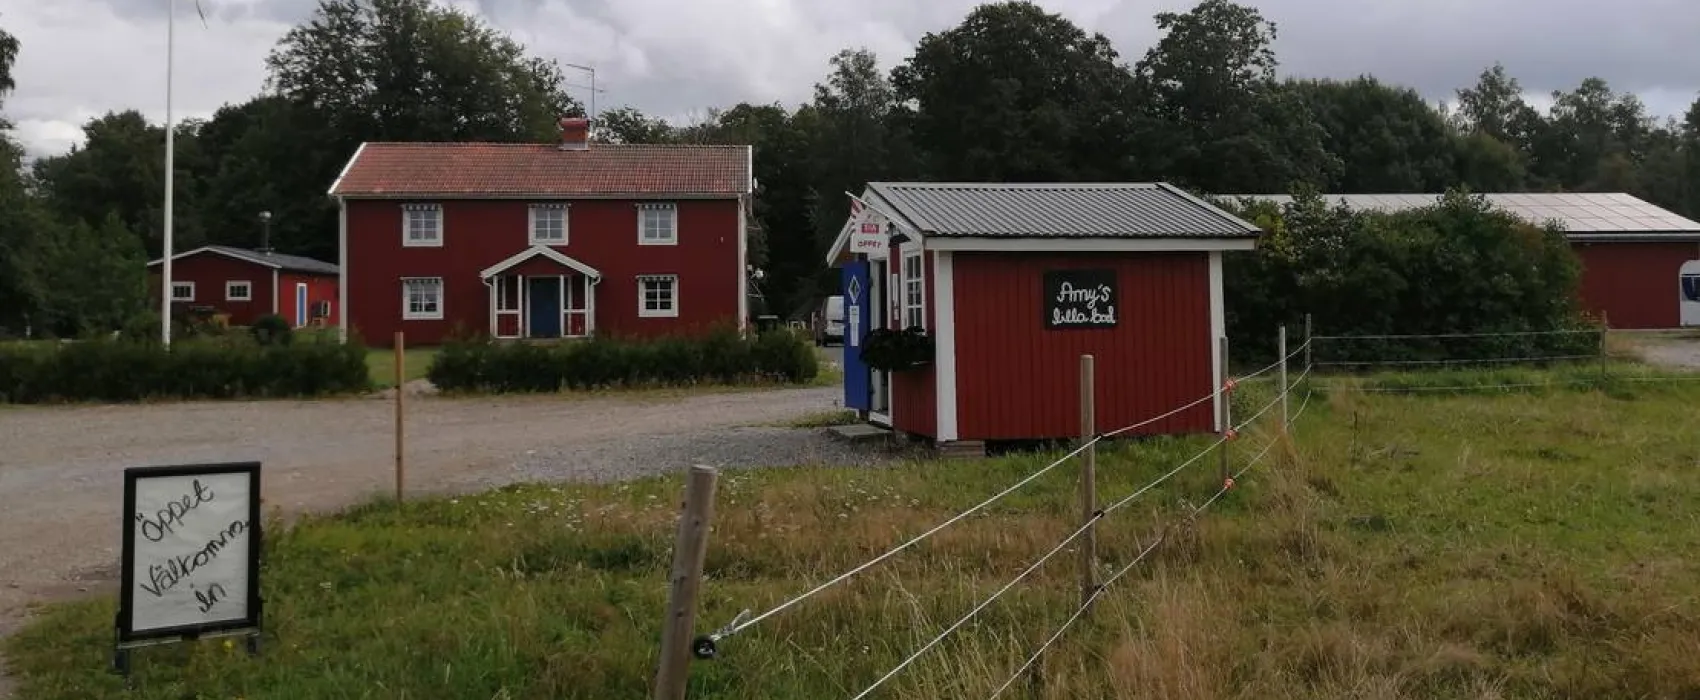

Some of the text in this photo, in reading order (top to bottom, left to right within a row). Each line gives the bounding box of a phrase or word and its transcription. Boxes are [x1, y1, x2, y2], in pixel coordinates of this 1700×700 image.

[1056, 281, 1111, 309] Amy's
[1052, 305, 1116, 325] lilla bod
[136, 479, 213, 542] Öppet
[191, 583, 227, 613] in
